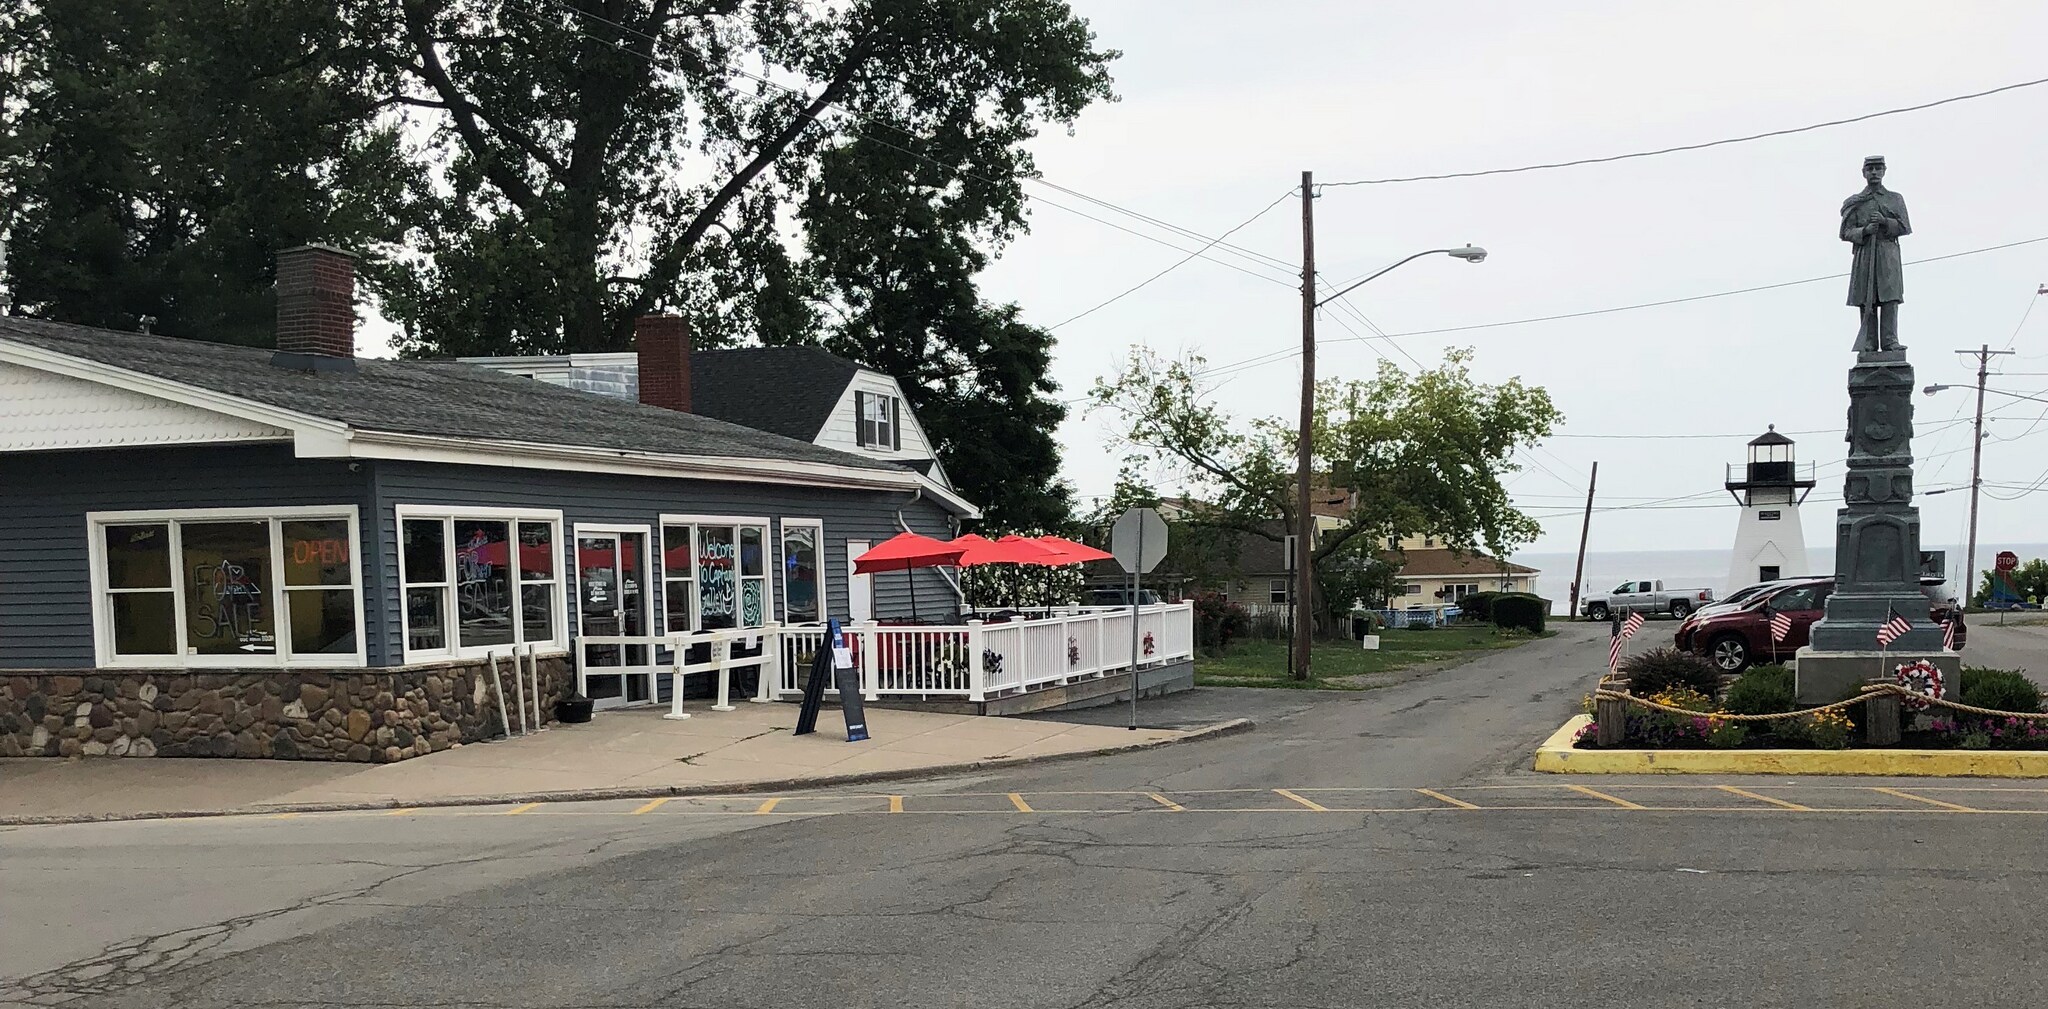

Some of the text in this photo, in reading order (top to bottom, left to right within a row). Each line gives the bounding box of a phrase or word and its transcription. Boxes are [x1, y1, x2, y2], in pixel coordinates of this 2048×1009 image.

[294, 540, 348, 565] OPEN
[698, 530, 734, 559] Welcome
[1997, 557, 2016, 565] STOP
[195, 564, 254, 602] FOR
[462, 579, 504, 614] SALE
[193, 603, 261, 638] SALE
